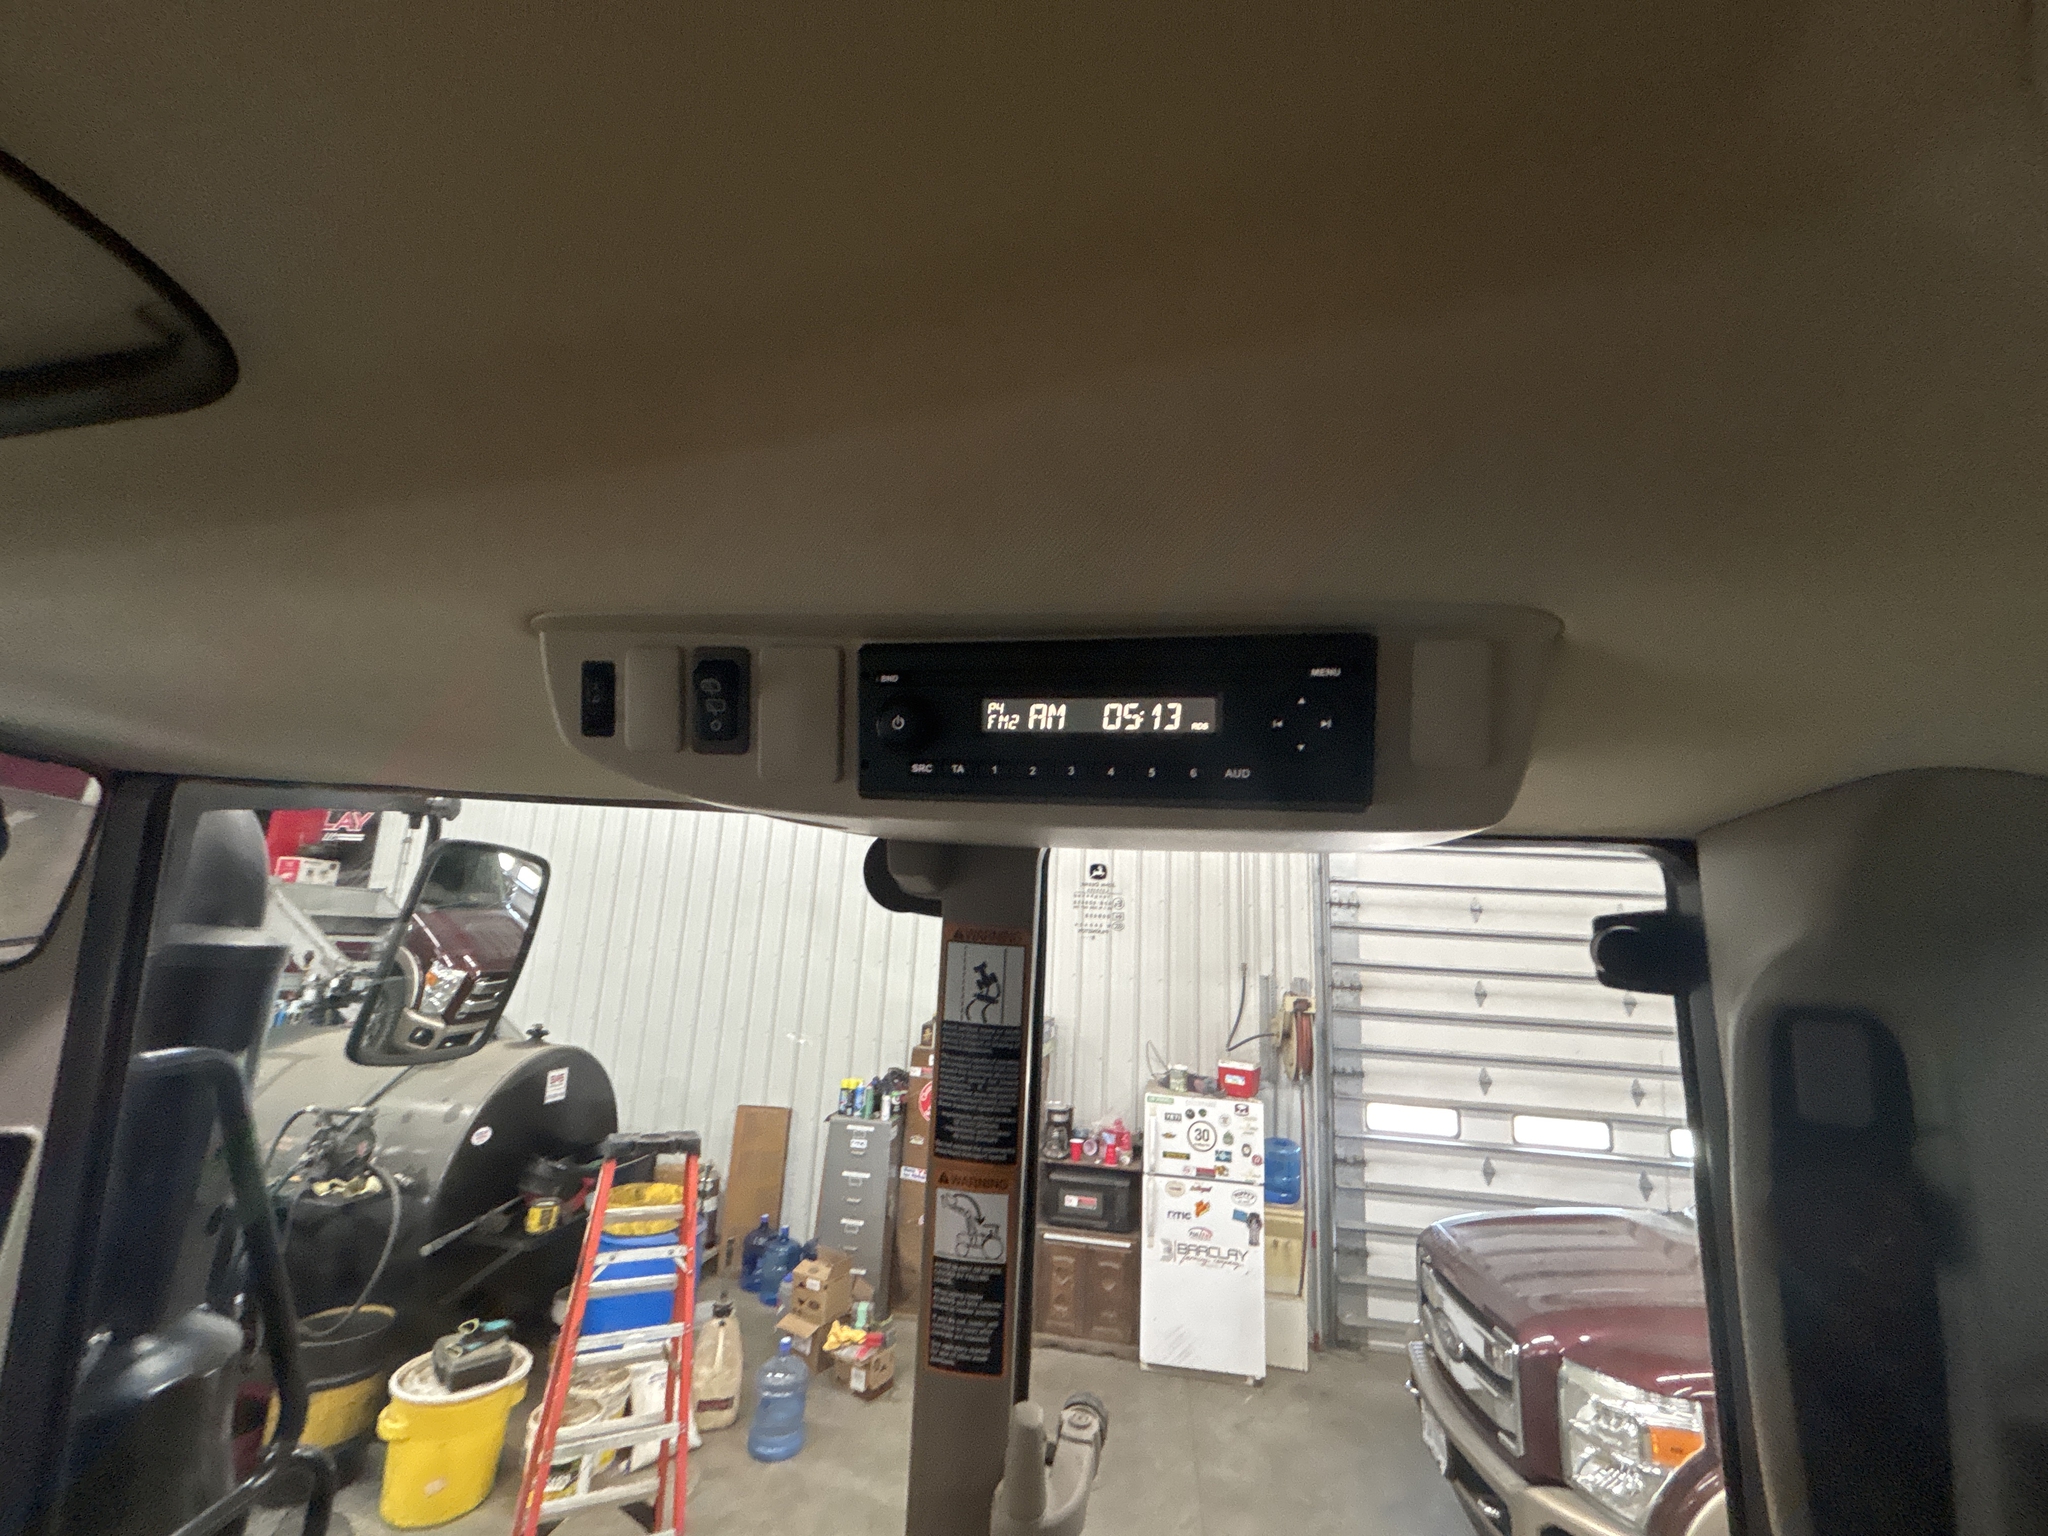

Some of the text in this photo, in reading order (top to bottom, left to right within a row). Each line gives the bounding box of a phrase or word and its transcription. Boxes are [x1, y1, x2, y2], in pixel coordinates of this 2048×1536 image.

[1310, 667, 1342, 677] MENU
[987, 702, 1005, 714] P4
[987, 714, 1020, 730] FM2
[1028, 703, 1067, 730] AM
[1102, 702, 1183, 730] 05:13
[910, 763, 1251, 779] SRC TA 1 2 3 4 5 6 AUD
[1194, 1128, 1210, 1142] 30
[1177, 1243, 1249, 1261] BARCLAY
